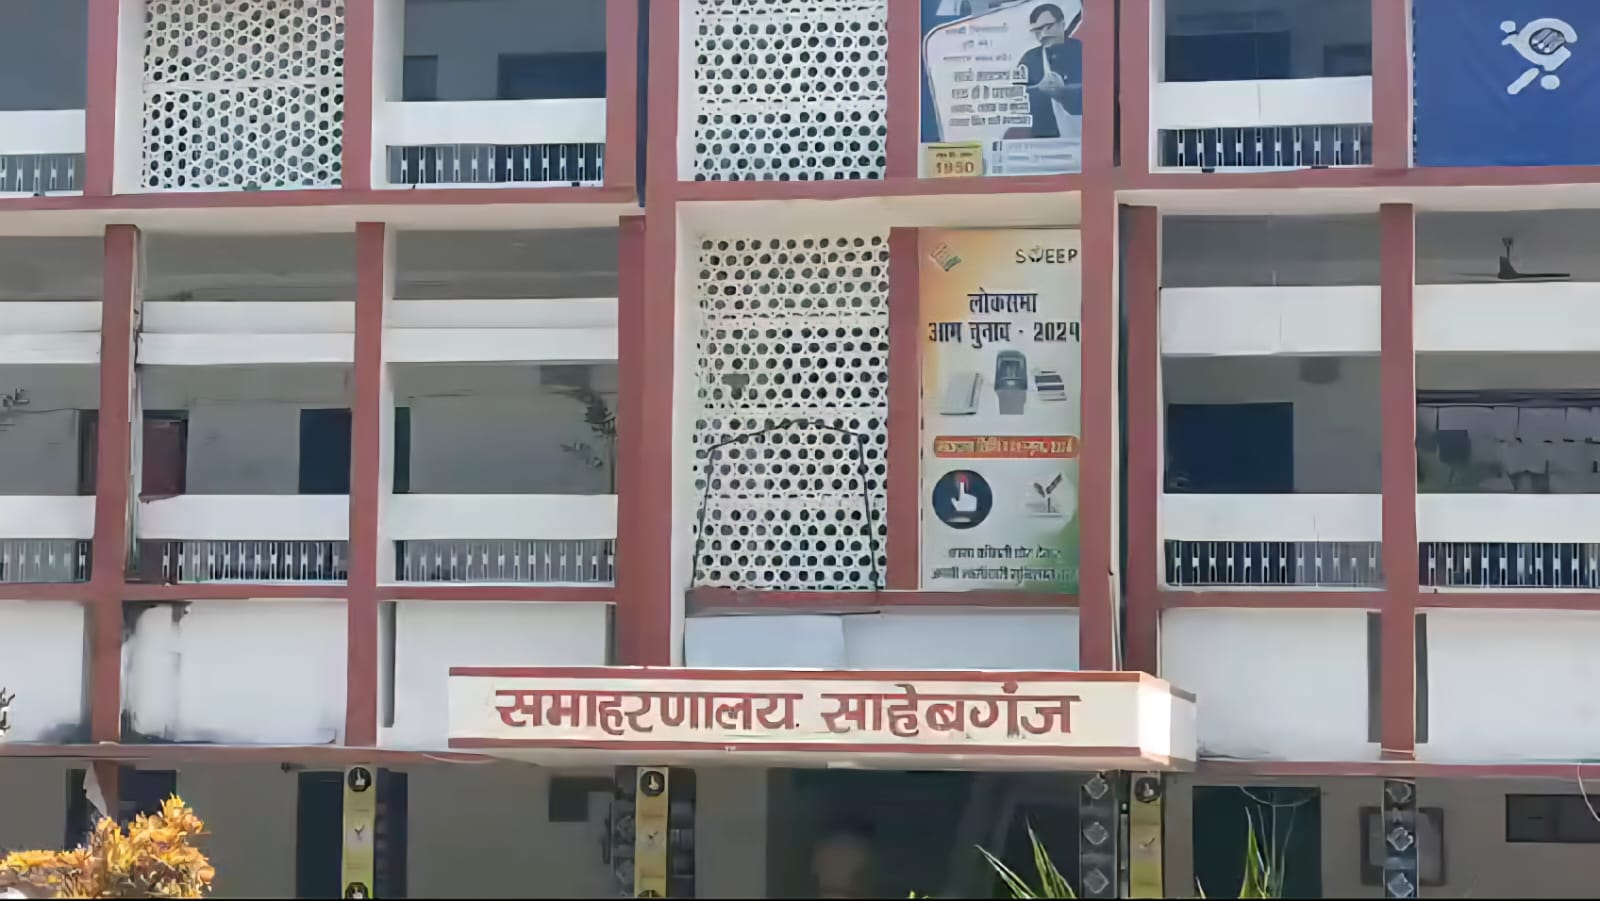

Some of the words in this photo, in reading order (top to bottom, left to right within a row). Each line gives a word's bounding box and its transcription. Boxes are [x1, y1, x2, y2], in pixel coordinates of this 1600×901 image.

[936, 162, 974, 174] 1950
[1016, 247, 1078, 264] SWEEP
[967, 286, 1038, 313] लोकसभा
[929, 322, 962, 343] आम
[968, 322, 1012, 349] चुनाव
[1033, 322, 1080, 343] 2024
[495, 689, 803, 735] समाहरणालय
[820, 681, 1081, 737] साहेबगंज
